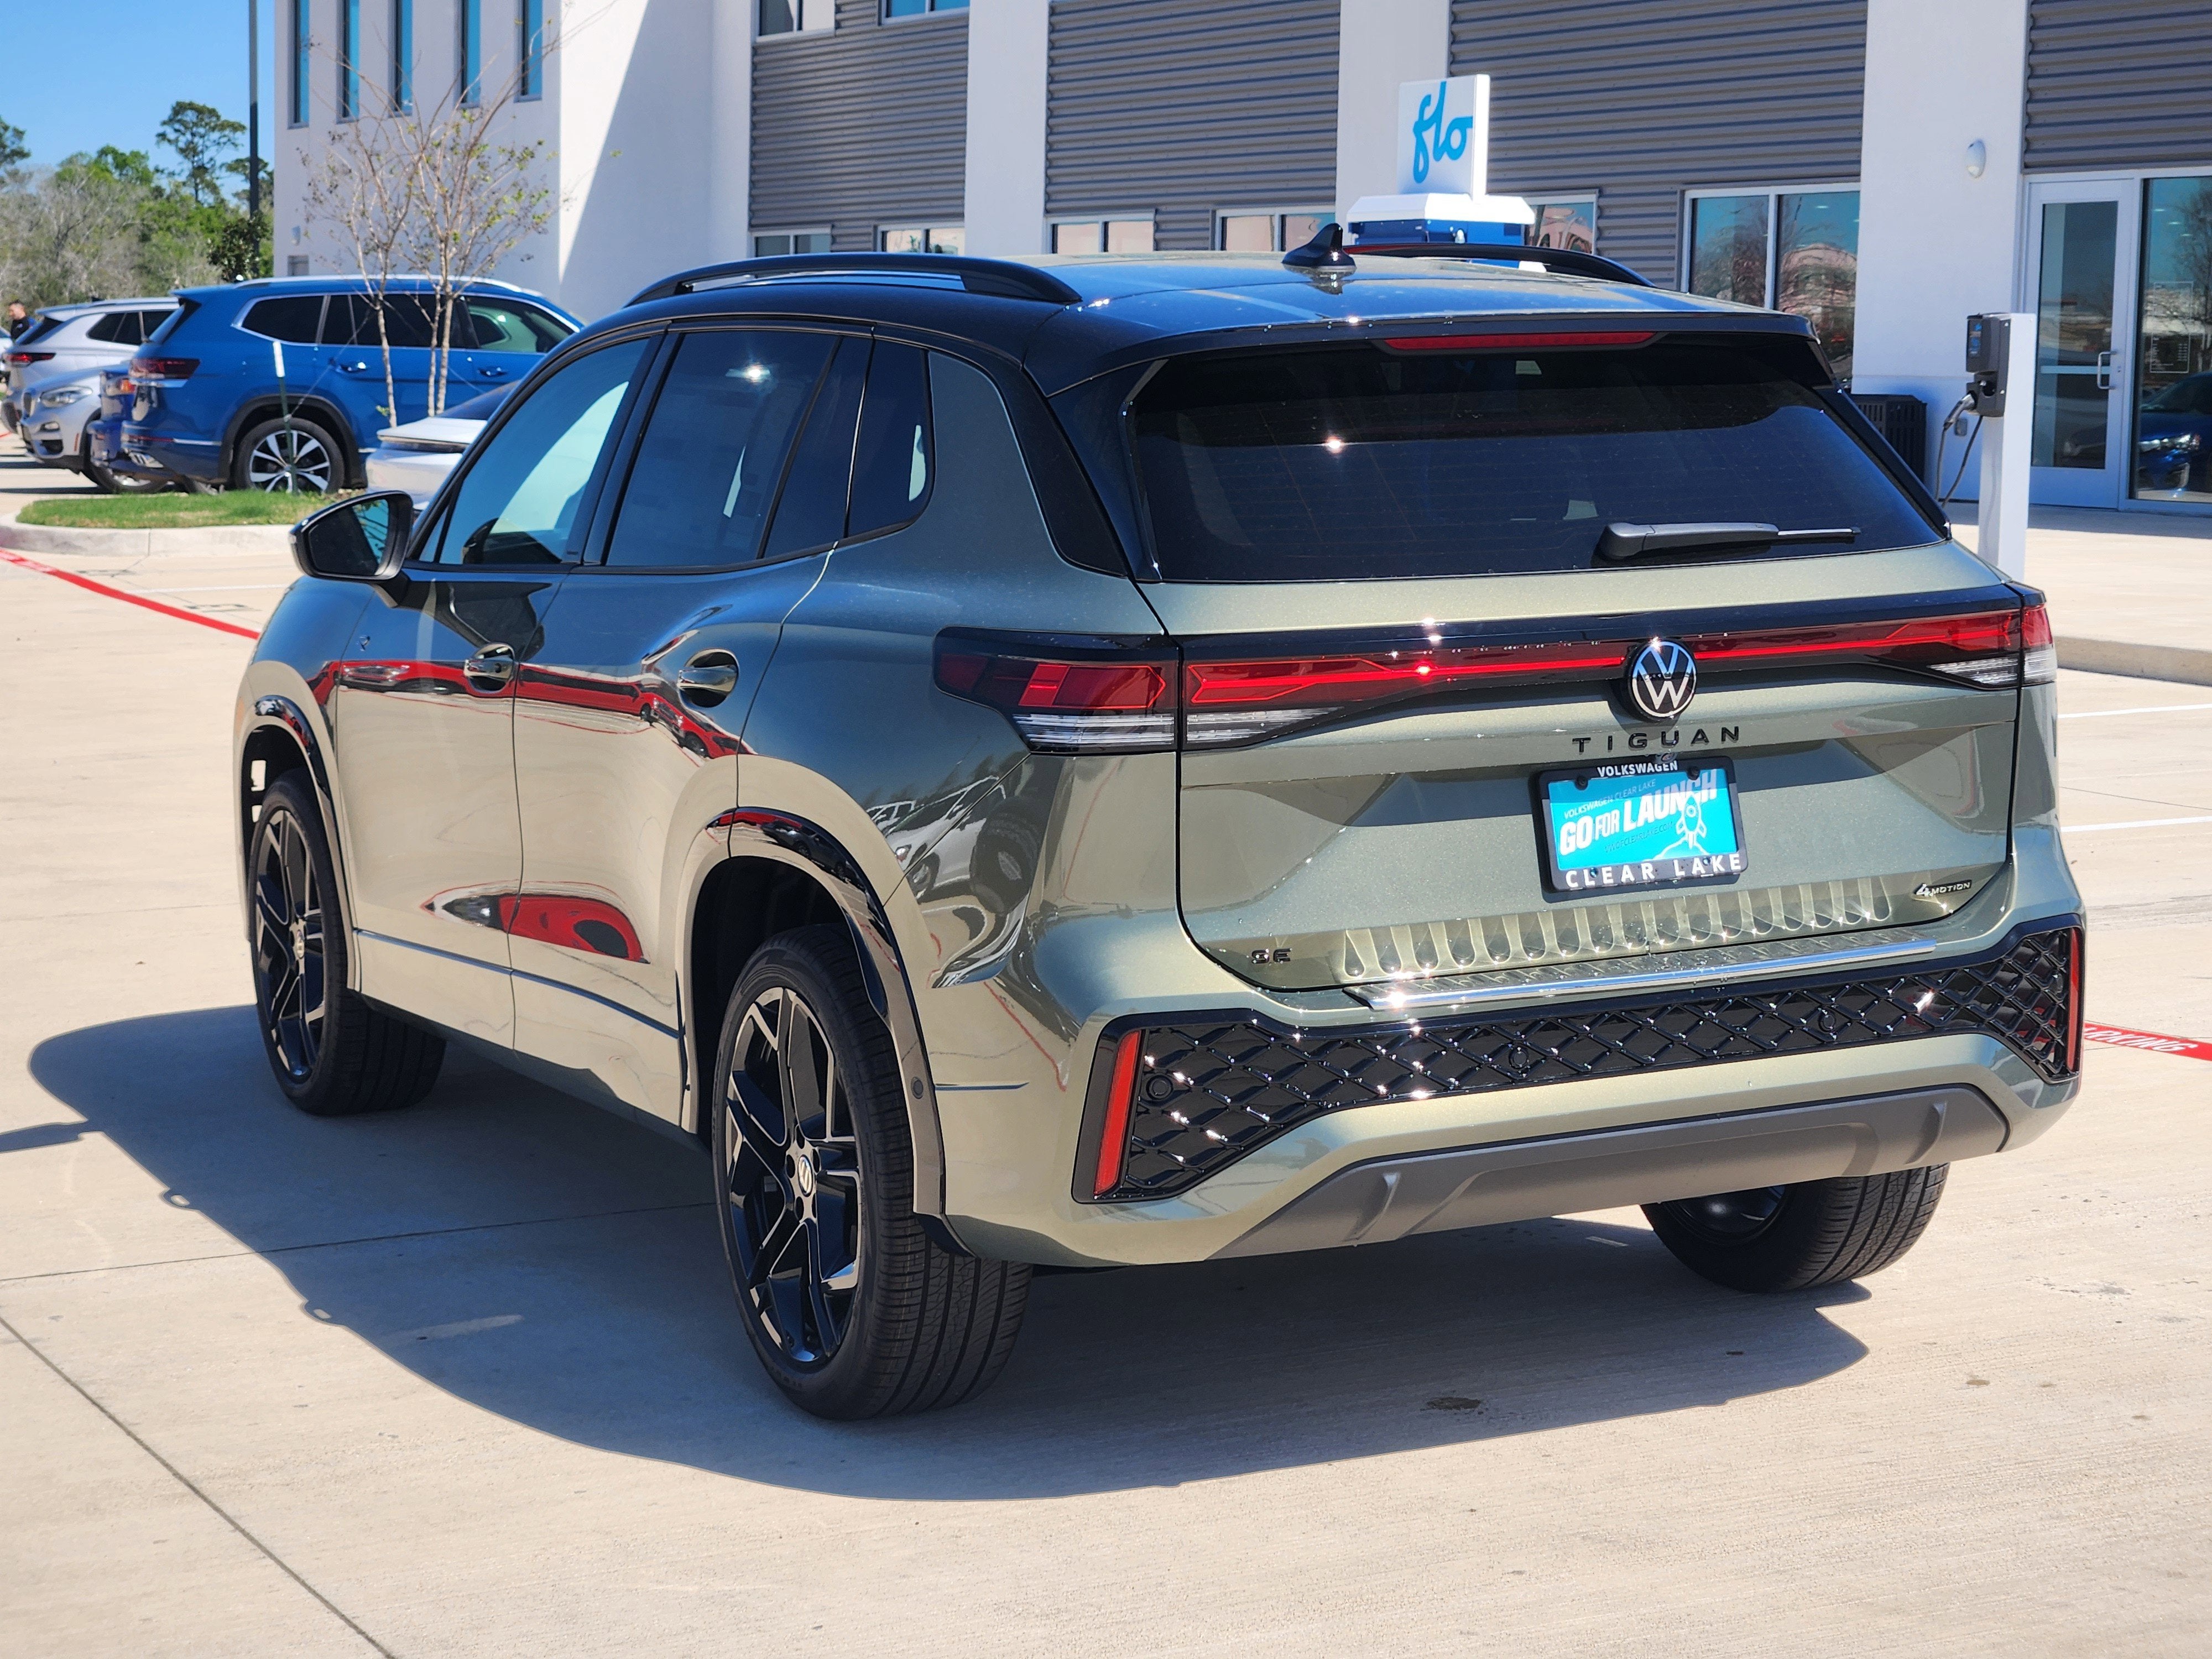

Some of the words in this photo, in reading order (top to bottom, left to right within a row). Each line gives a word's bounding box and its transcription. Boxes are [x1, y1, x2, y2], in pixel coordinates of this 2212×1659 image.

[1412, 81, 1473, 184] flo
[1572, 726, 1739, 753] TIGUAN
[1597, 760, 1678, 777] VOLKSWAGEN
[1559, 816, 1593, 855] GO
[1595, 809, 1620, 841] FOR
[1623, 769, 1718, 832] LAUNCH
[1564, 794, 1614, 819] VOLKSWAGEN
[1614, 785, 1637, 800] CLEAR
[1638, 779, 1656, 792] LAKE
[1566, 863, 1655, 888] CLEAR
[1674, 853, 1741, 876] LAKE
[1916, 883, 1970, 897] 4MOTION
[1251, 948, 1292, 963] SE
[2084, 1027, 2198, 1051] RKING
